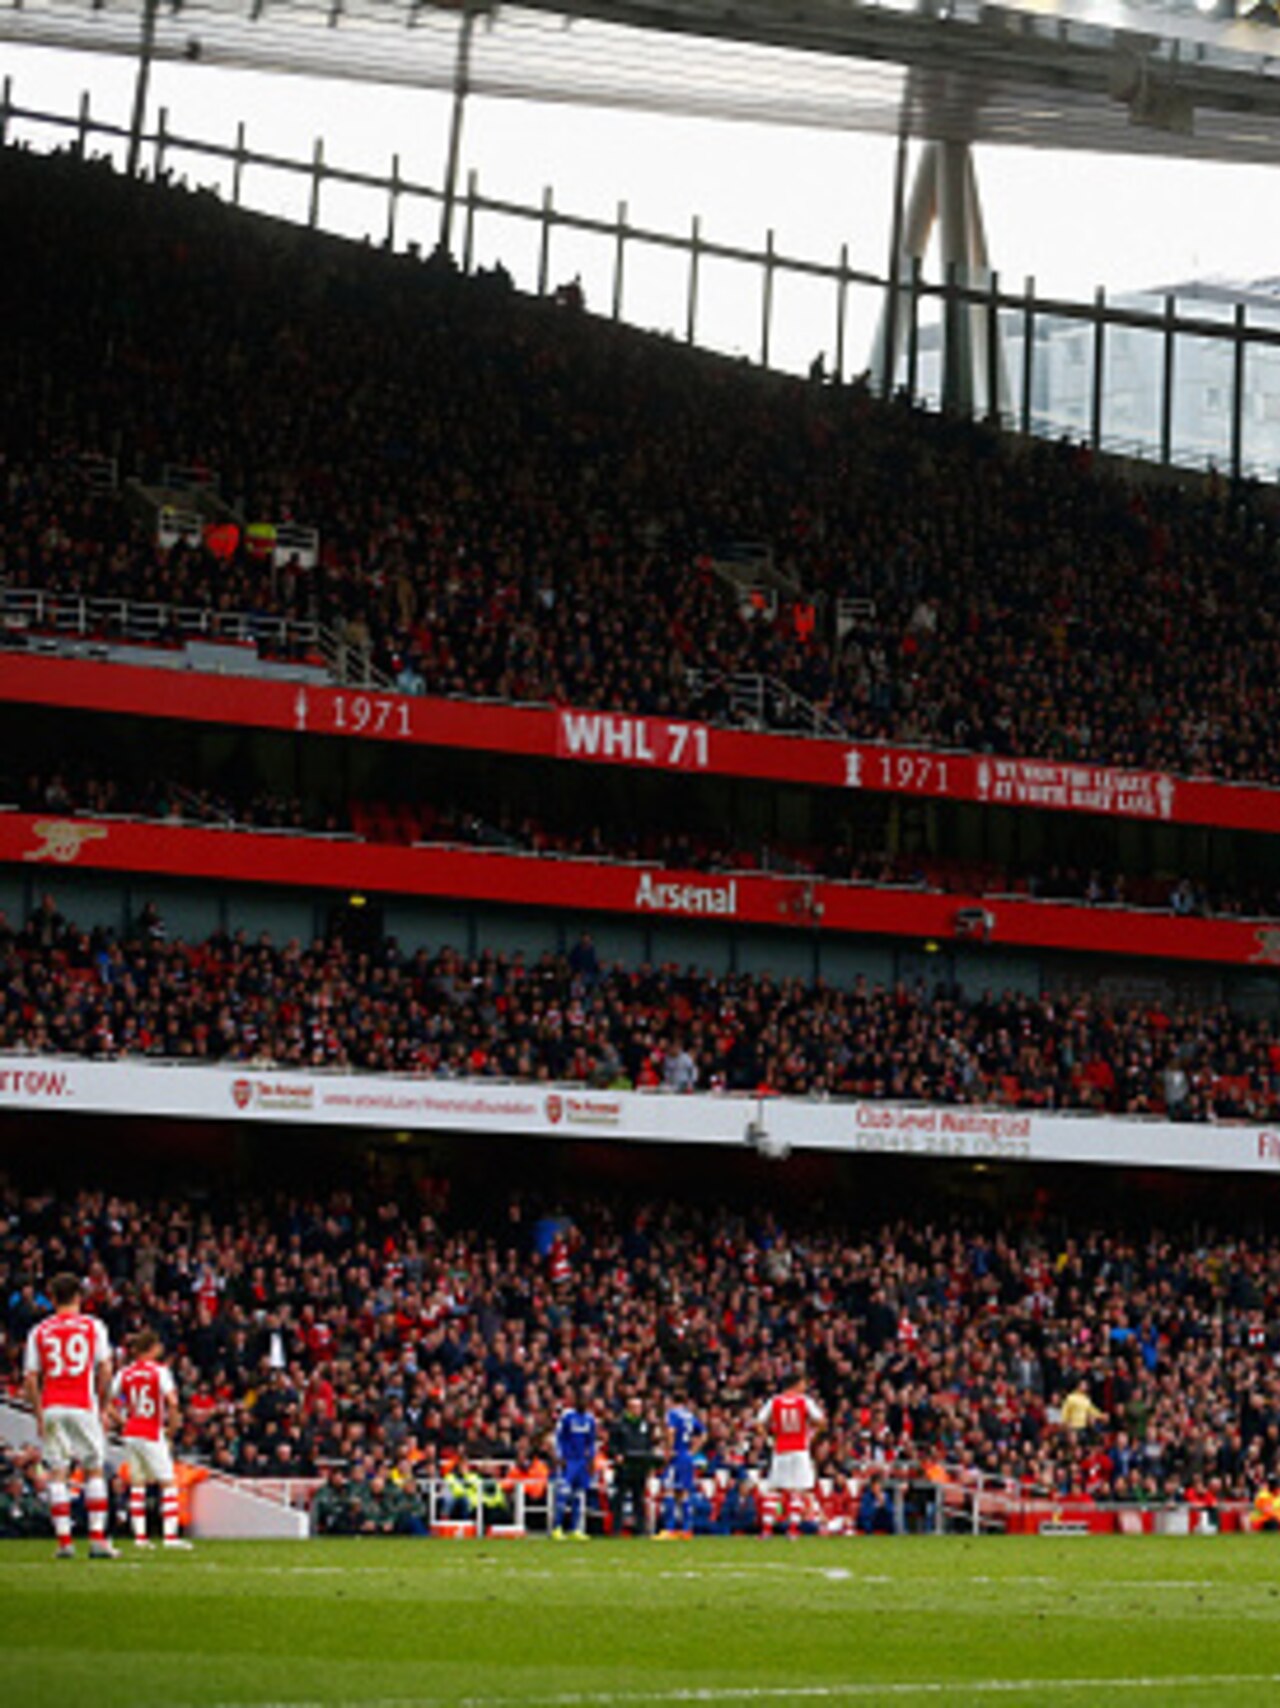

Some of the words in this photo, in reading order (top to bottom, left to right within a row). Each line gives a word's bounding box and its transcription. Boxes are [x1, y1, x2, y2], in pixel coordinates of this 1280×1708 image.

[333, 695, 412, 735] 1971
[561, 711, 655, 761] WHL
[667, 724, 710, 766] 71
[879, 755, 949, 791] 1971
[635, 873, 737, 915] Arsenal
[43, 1333, 90, 1377] 39
[130, 1384, 155, 1418] 16
